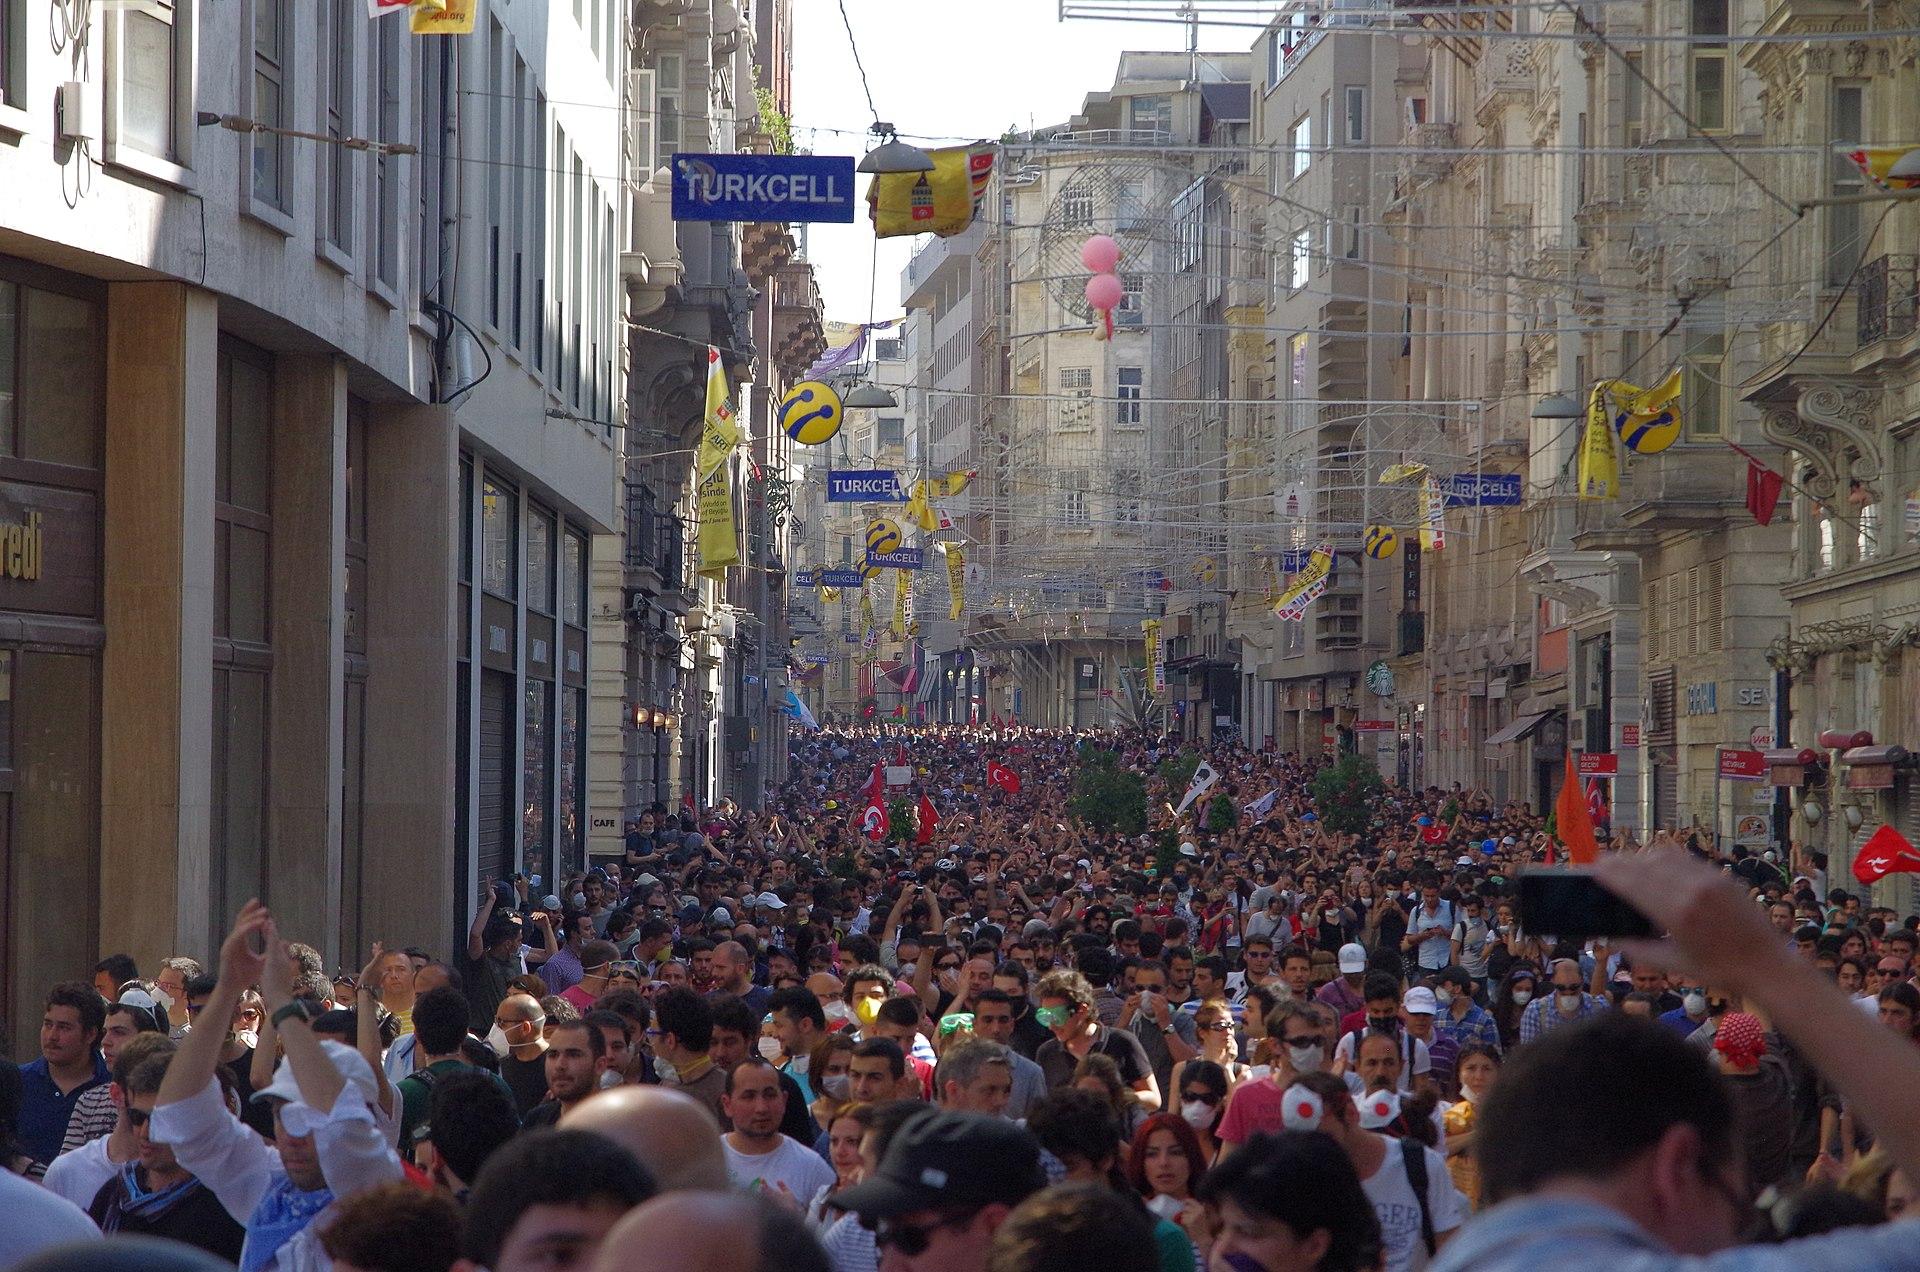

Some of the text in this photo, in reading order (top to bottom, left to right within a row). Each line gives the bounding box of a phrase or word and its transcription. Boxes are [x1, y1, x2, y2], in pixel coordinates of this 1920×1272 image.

[685, 173, 844, 203] TURKCELL
[868, 551, 920, 564] TURKCELL
[593, 819, 615, 828] CAFE
